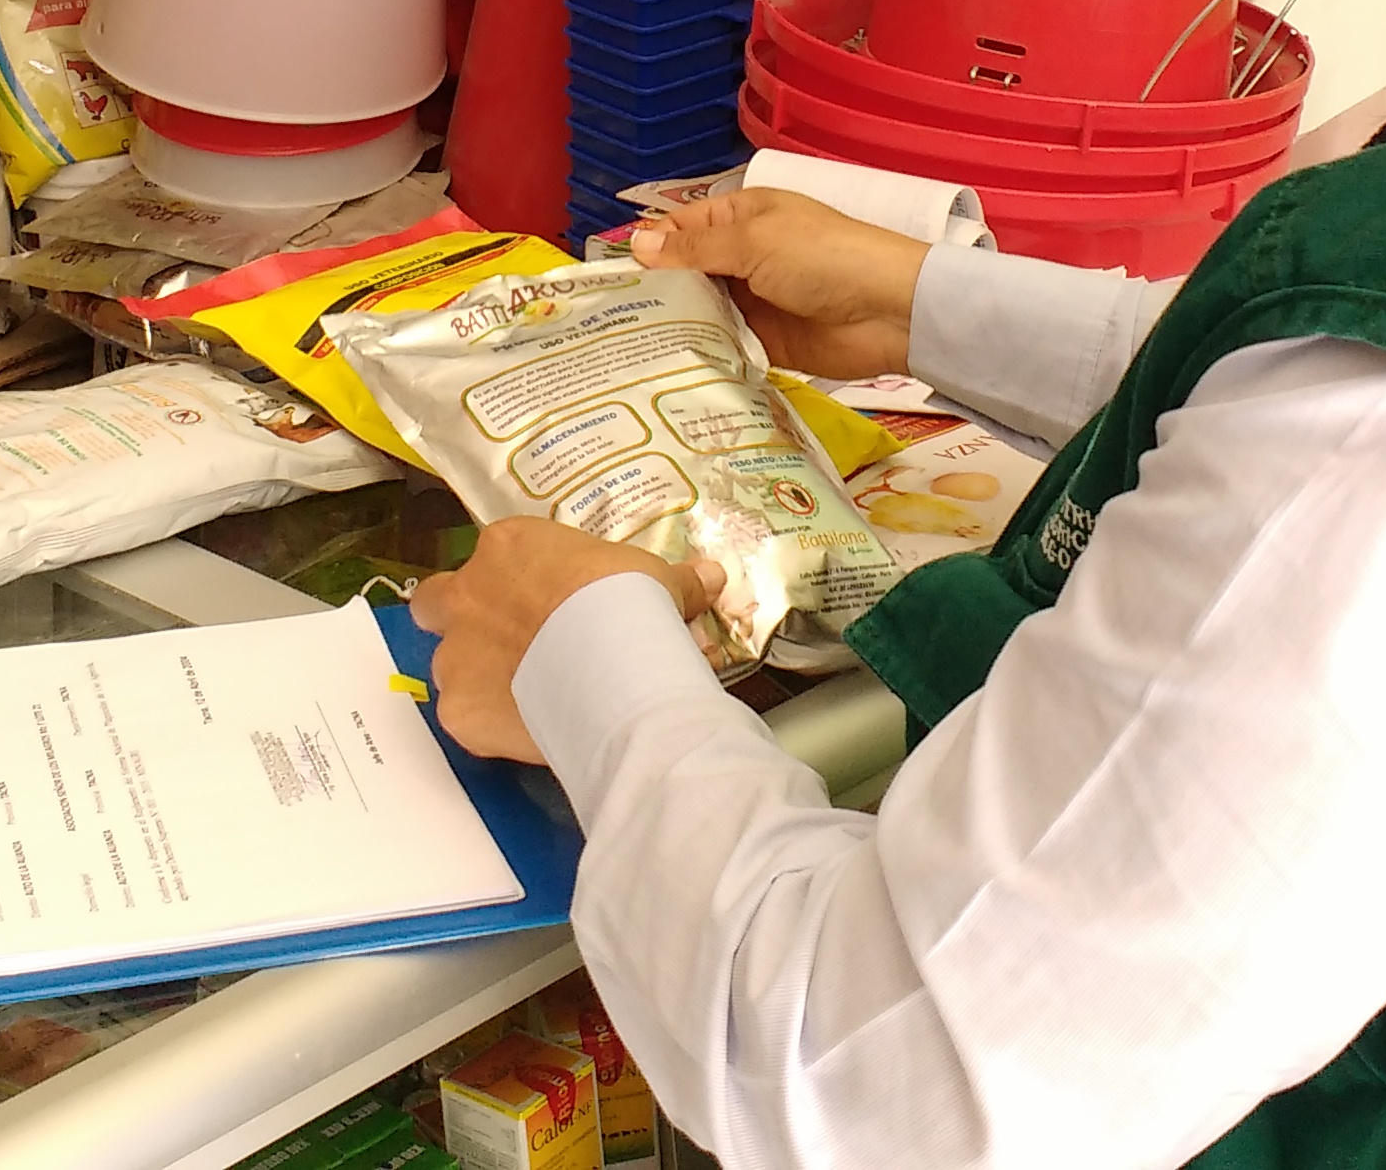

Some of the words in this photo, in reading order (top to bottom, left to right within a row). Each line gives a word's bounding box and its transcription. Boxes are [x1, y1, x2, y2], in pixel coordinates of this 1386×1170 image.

[42, 2, 74, 15] para
[371, 251, 444, 281] VETERINARIO
[581, 315, 600, 328] DE
[603, 299, 665, 318] INGESTA
[540, 338, 564, 350] USO
[530, 412, 617, 460] ALMACENAMIENTO
[570, 486, 604, 515] FORMA
[606, 477, 620, 490] DE
[621, 468, 642, 482] USO
[797, 531, 868, 550] Battilana
